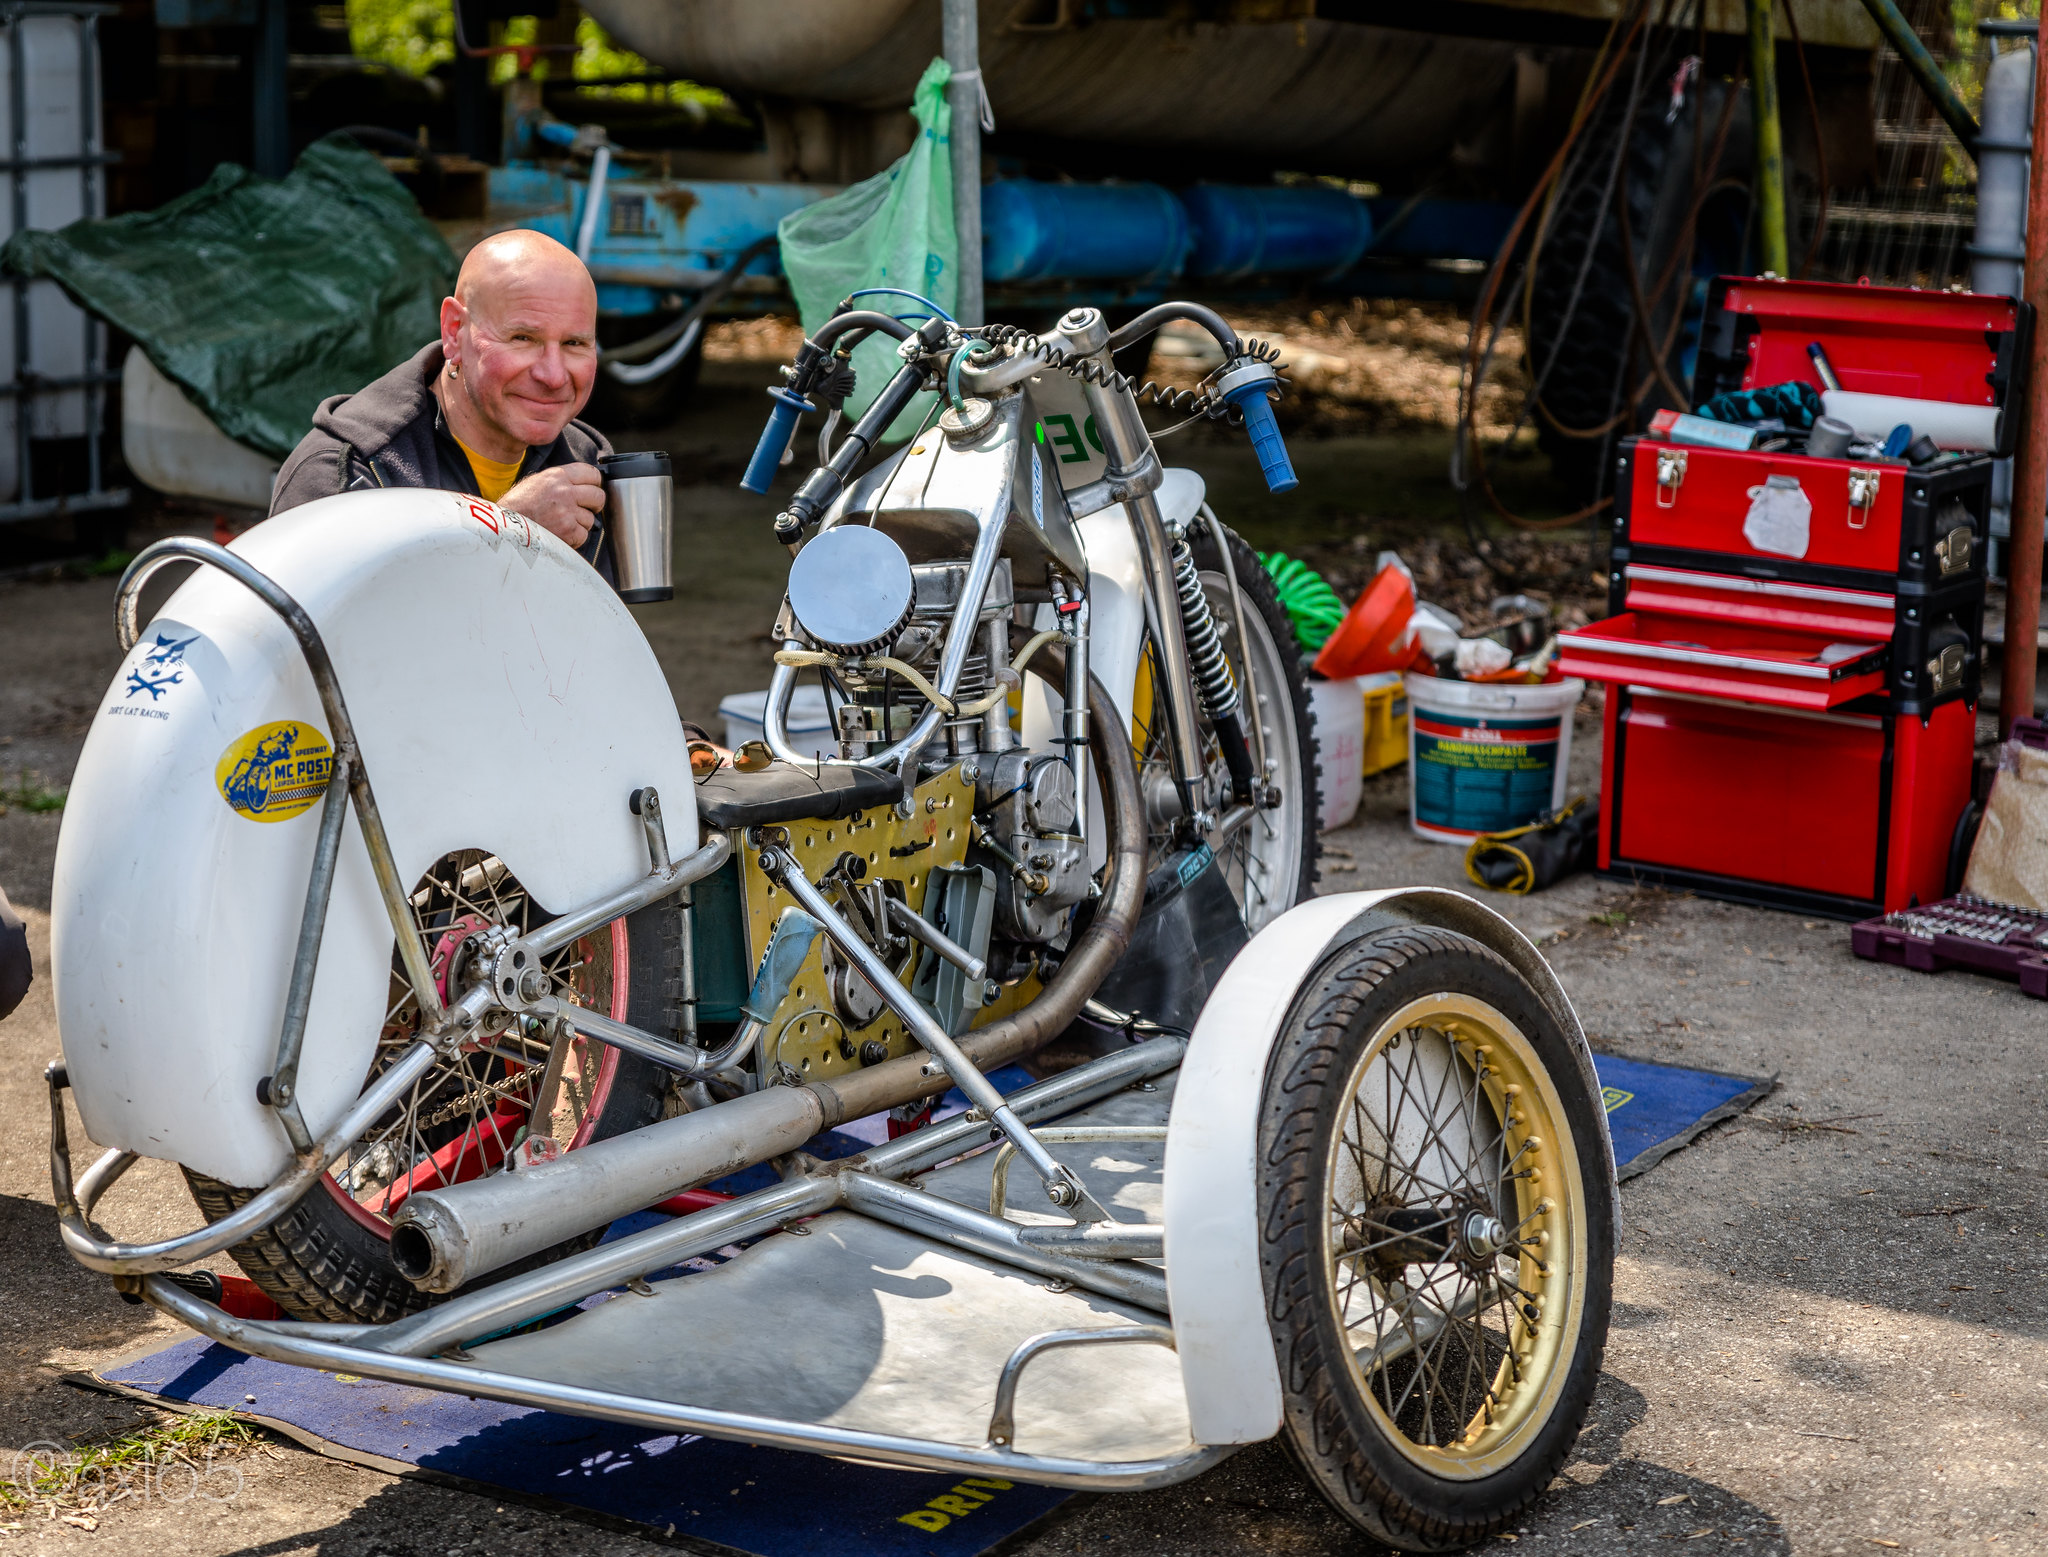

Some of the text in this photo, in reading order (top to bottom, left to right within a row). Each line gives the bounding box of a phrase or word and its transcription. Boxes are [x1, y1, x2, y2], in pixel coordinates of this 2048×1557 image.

[108, 706, 170, 721] DIRT CAT RACING
[295, 745, 328, 757] SPEEDWAY
[274, 757, 331, 780] MC POST
